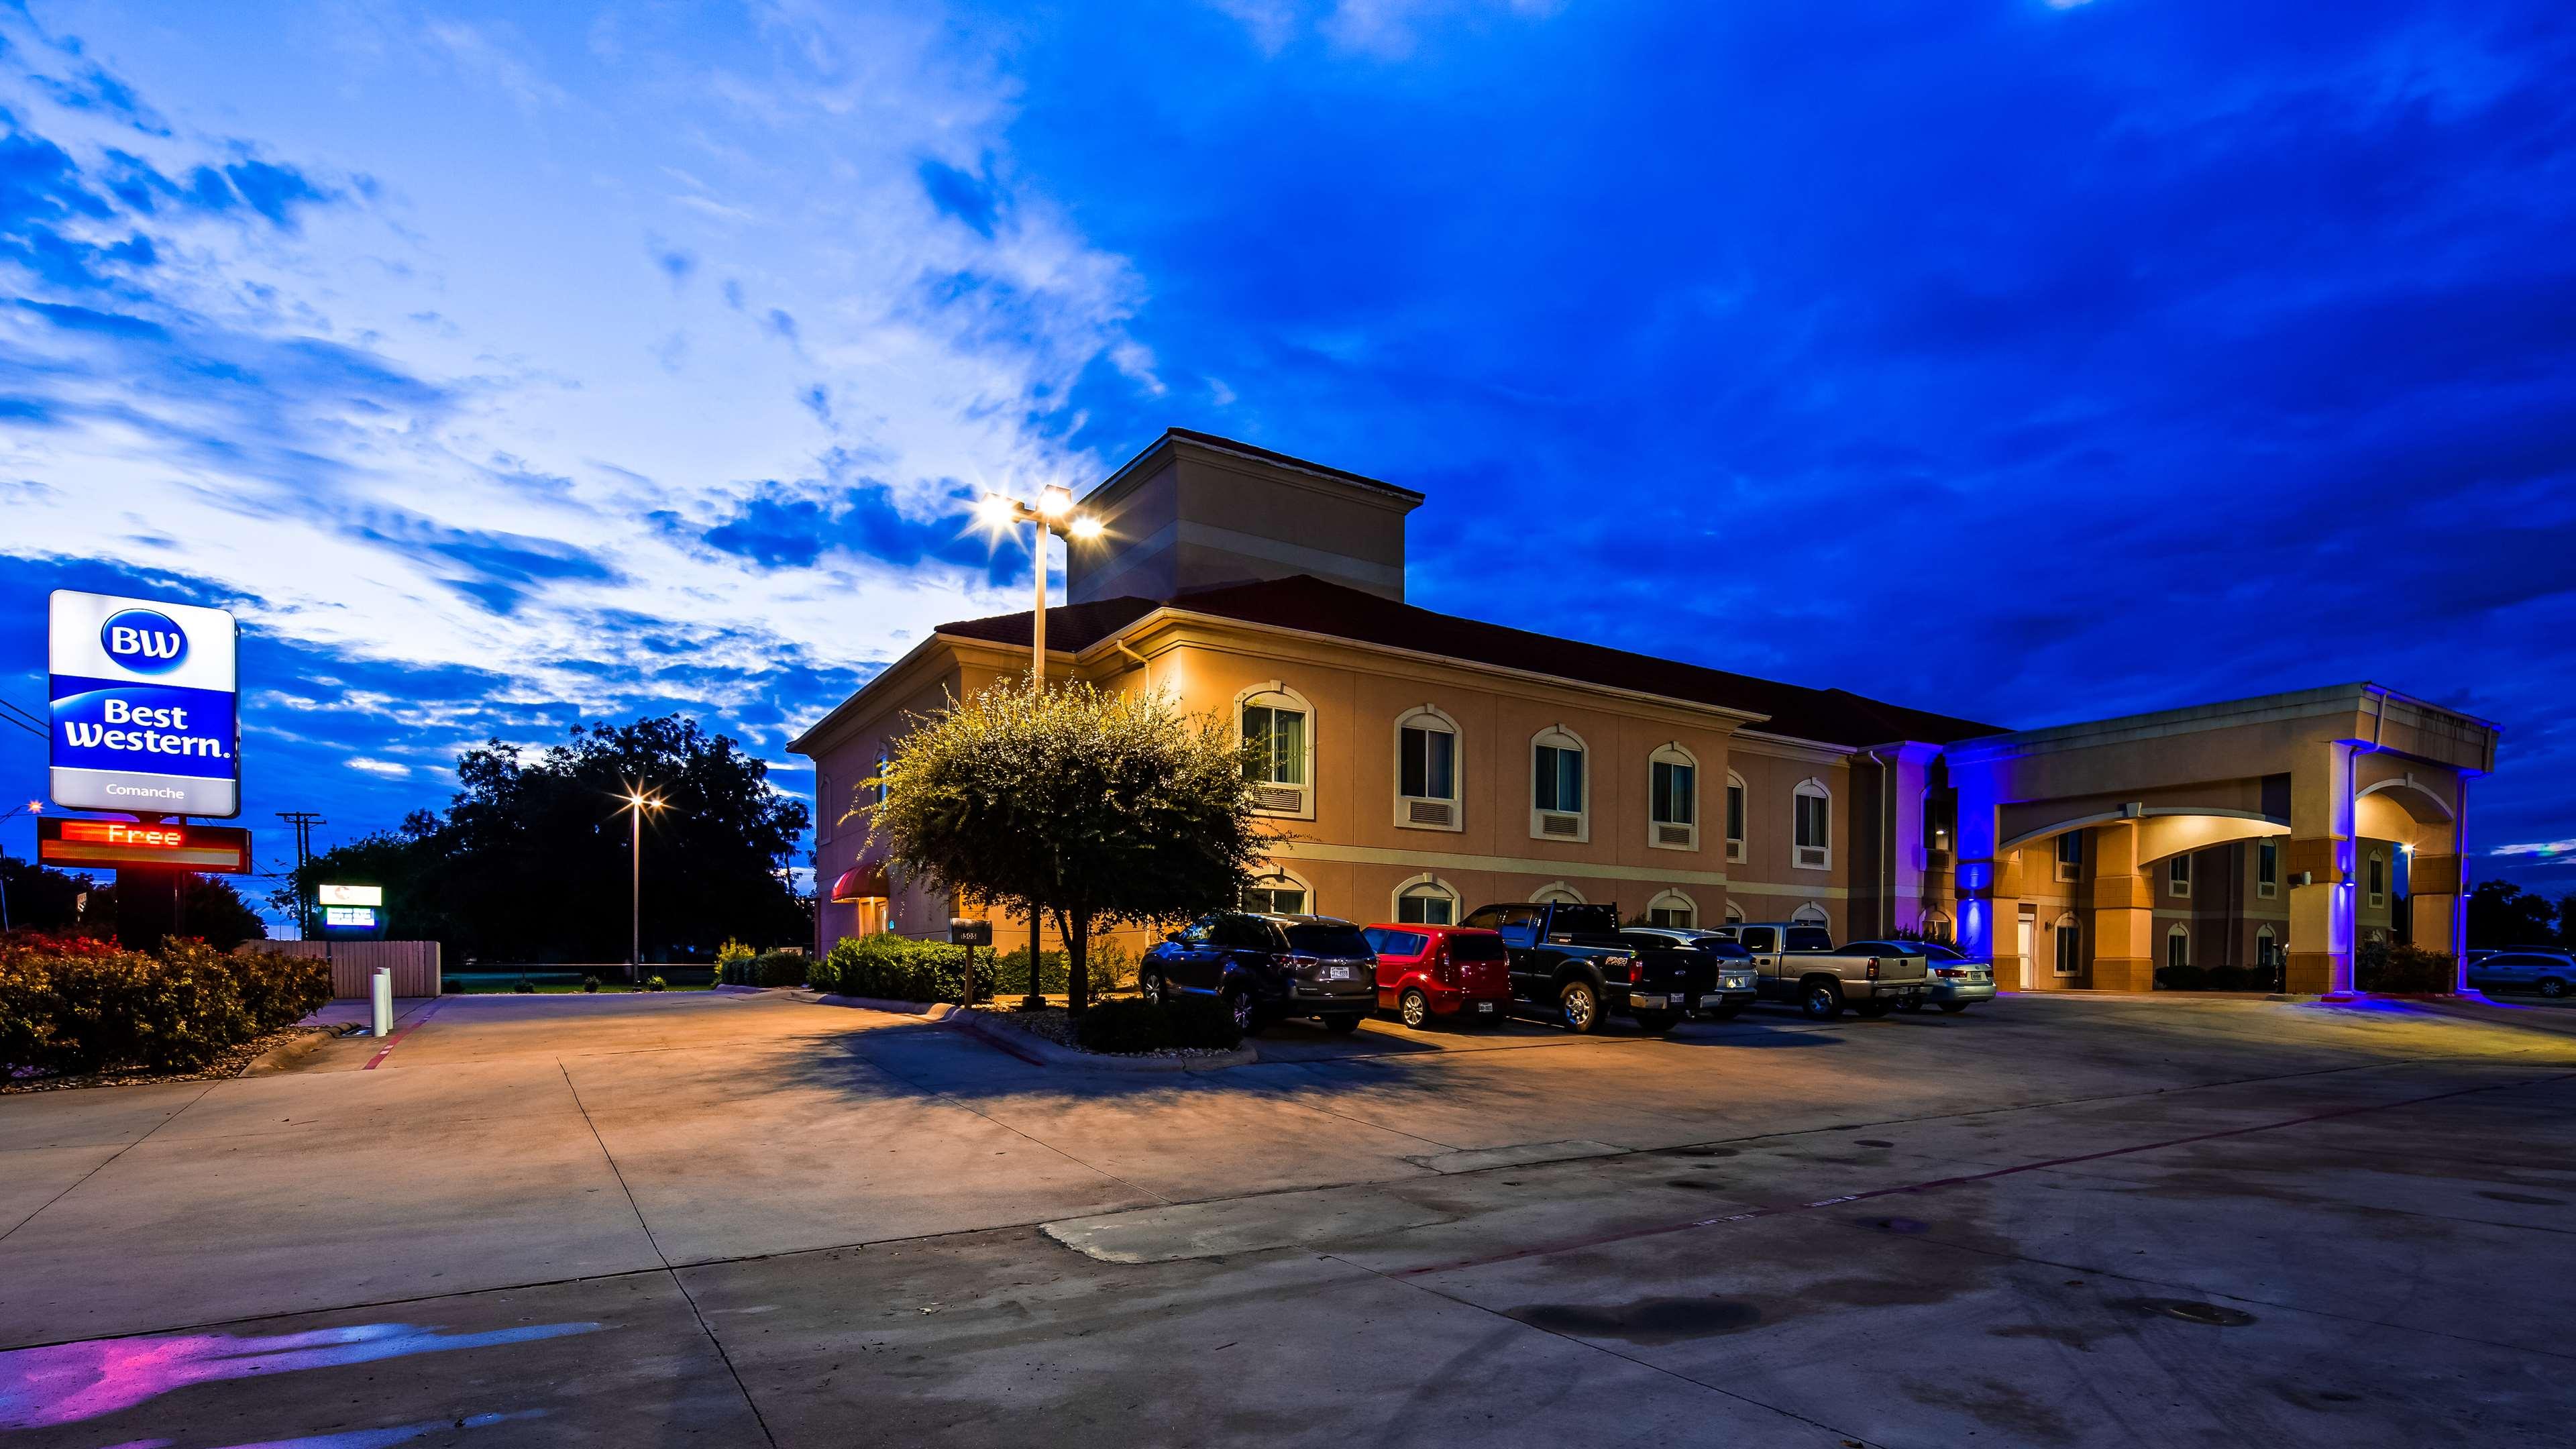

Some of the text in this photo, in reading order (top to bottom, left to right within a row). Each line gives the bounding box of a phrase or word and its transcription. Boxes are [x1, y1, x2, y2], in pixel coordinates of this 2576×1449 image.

[112, 627, 180, 659] BW
[105, 699, 188, 730] Best
[106, 784, 184, 800] Comanche
[109, 824, 181, 845] Free
